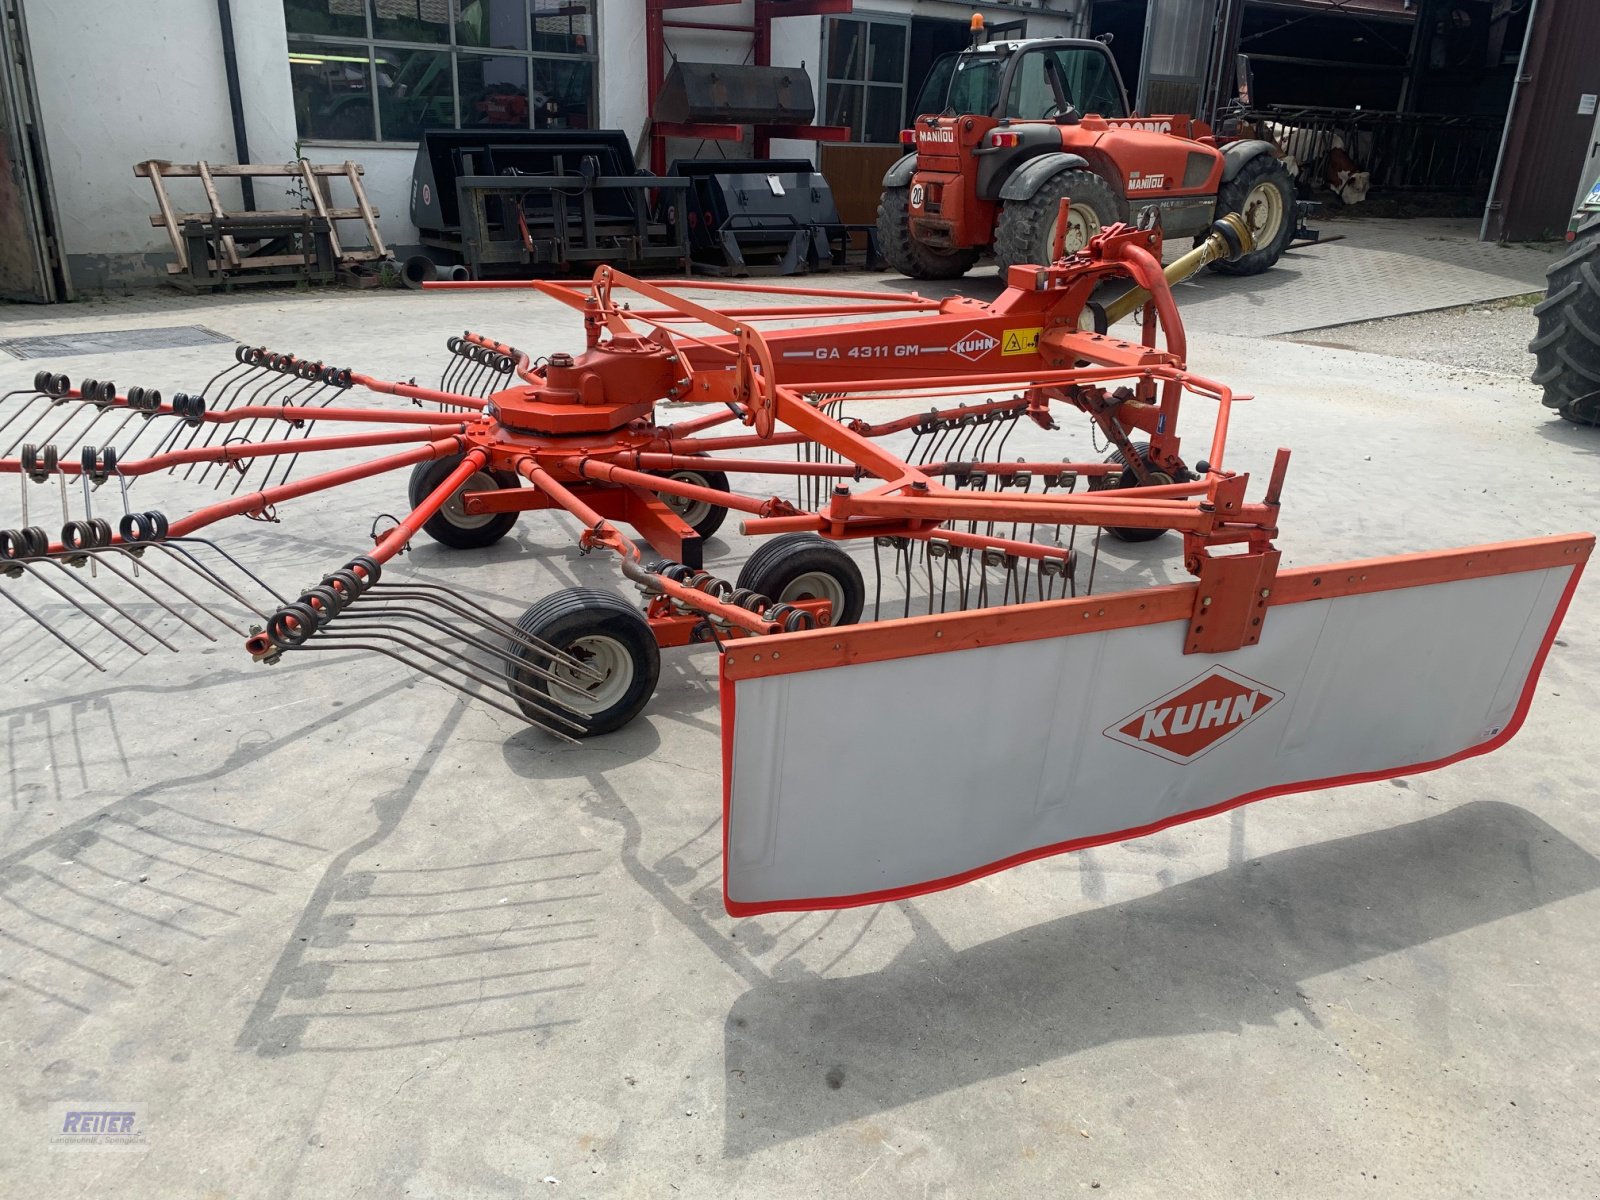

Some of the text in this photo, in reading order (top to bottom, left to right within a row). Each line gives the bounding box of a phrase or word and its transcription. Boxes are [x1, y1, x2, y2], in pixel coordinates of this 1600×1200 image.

[920, 127, 954, 143] MANITOU
[1128, 174, 1165, 190] MANITOU
[913, 187, 922, 204] 20
[816, 345, 919, 359] GA 4311 GM
[956, 338, 995, 353] KUHN
[1138, 689, 1260, 741] KUHN
